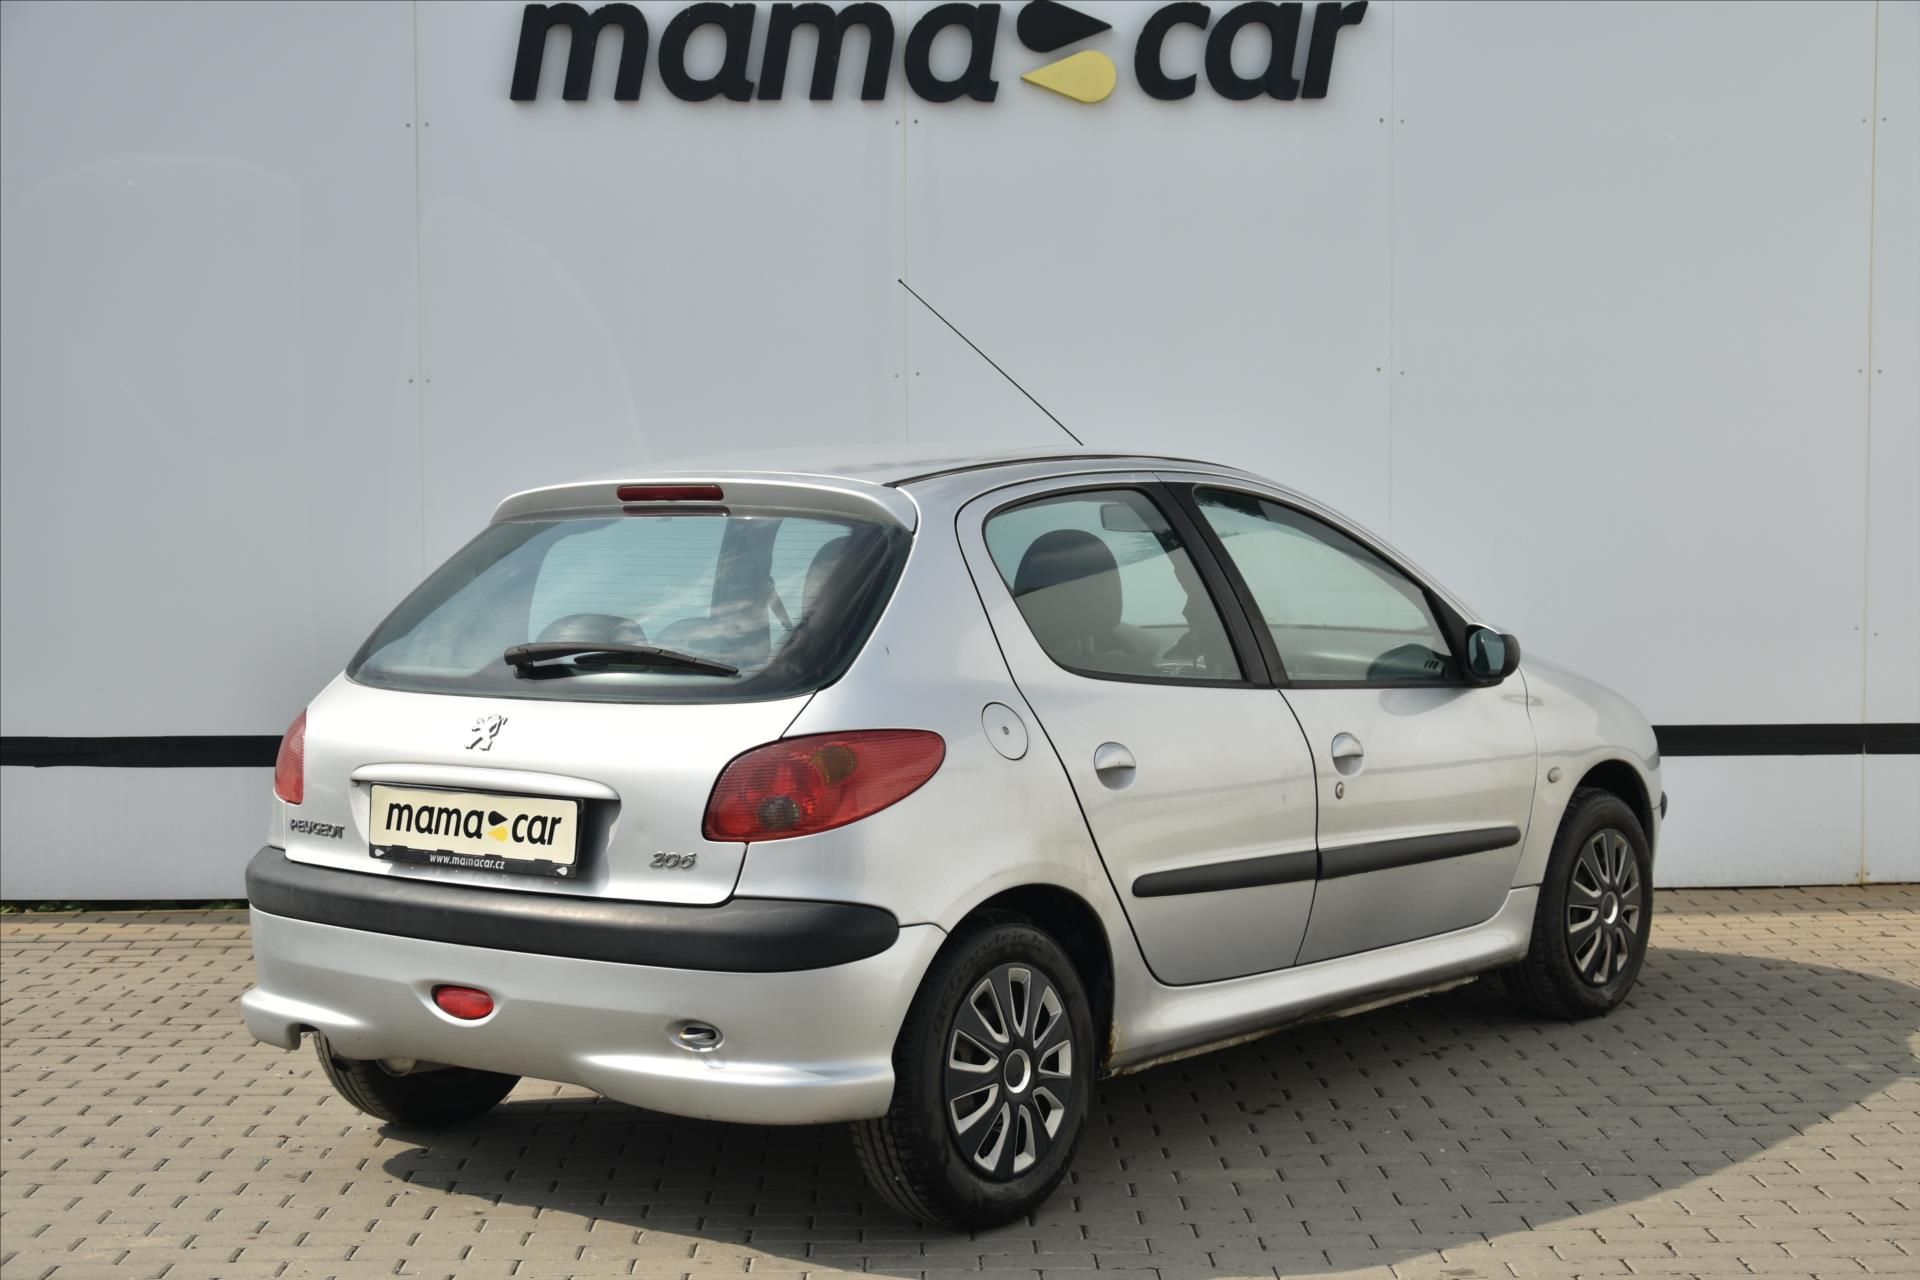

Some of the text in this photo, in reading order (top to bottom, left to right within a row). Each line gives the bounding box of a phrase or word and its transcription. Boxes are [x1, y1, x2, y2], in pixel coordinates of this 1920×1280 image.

[510, 0, 1368, 103] mama car
[290, 819, 345, 839] PEUGEOT
[385, 802, 562, 846] mama car
[429, 854, 505, 870] www.mamacar.cz
[649, 851, 697, 870] 206
